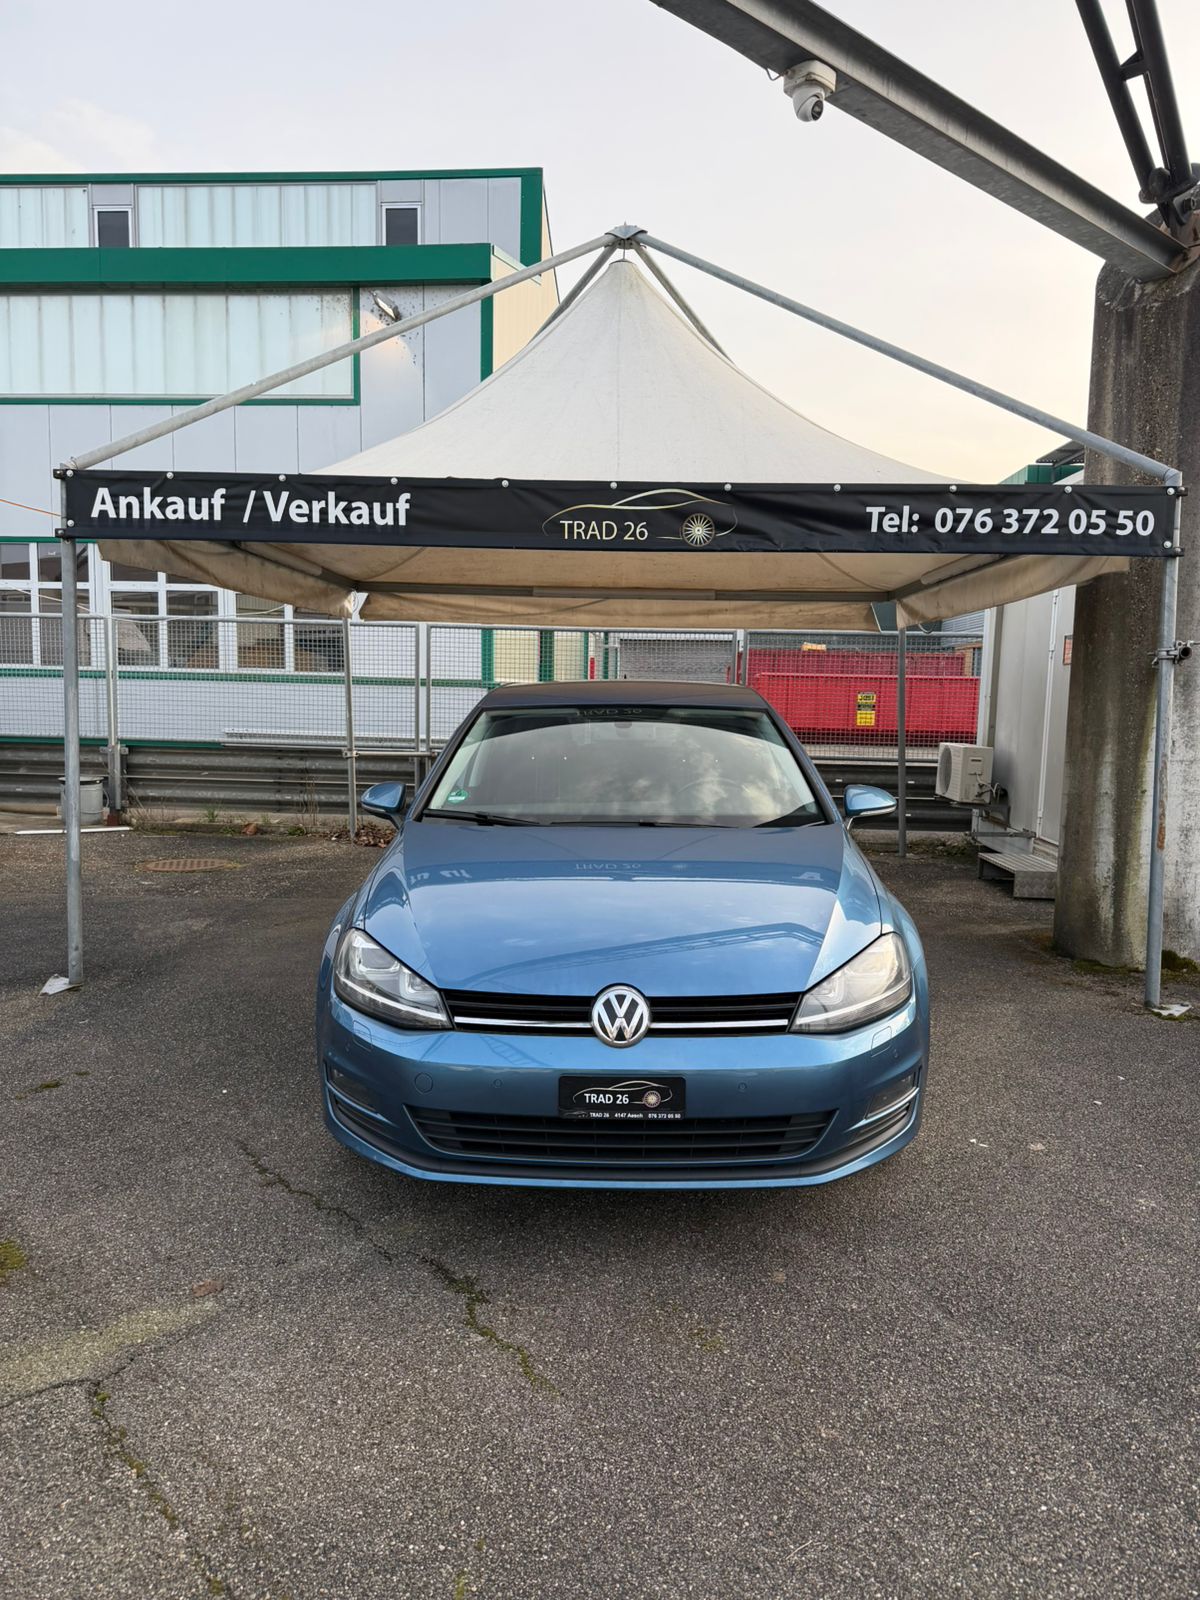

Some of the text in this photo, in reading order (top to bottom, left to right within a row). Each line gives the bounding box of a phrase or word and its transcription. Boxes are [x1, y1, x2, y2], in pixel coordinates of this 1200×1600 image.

[91, 487, 226, 521] Ankauf
[560, 520, 649, 541] TRAD 26
[866, 506, 1155, 536] Tel: 076 372 05 50
[584, 1093, 629, 1104] TRAD 26
